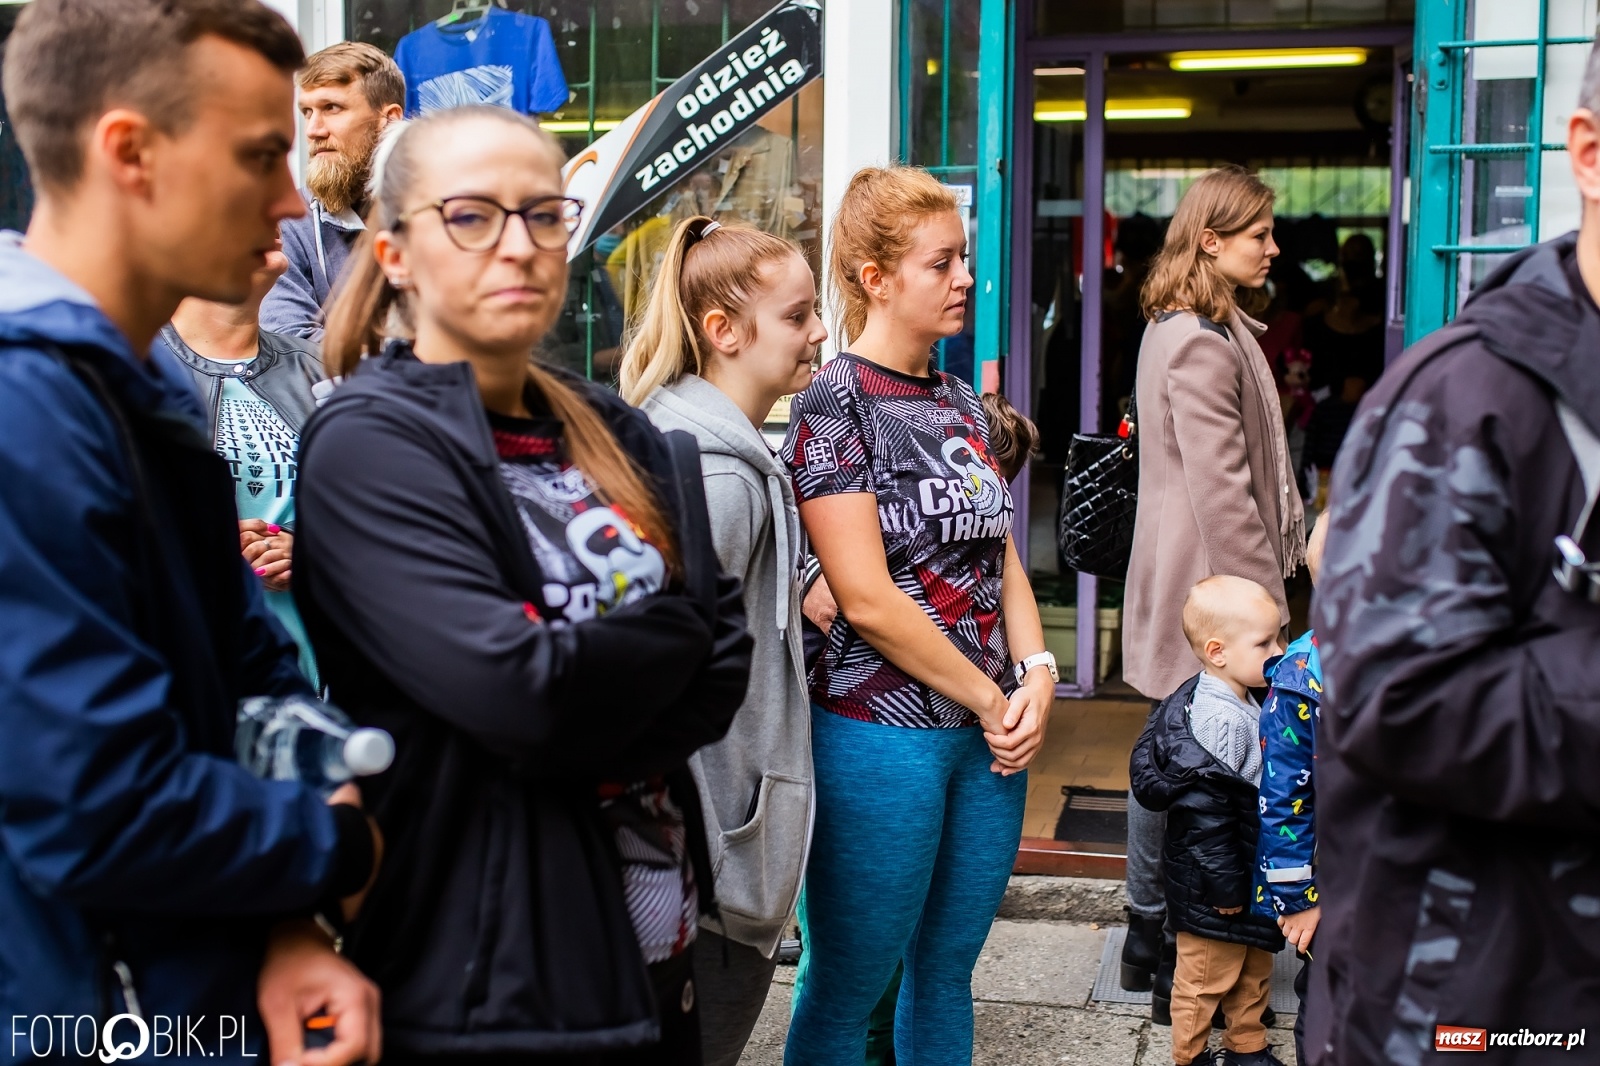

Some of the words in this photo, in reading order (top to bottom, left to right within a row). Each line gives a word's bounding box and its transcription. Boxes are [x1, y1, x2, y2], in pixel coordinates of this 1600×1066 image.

[676, 26, 788, 119] odzież
[635, 58, 806, 192] zachodnia
[1298, 703, 1311, 720] 2
[1296, 769, 1311, 786] 3
